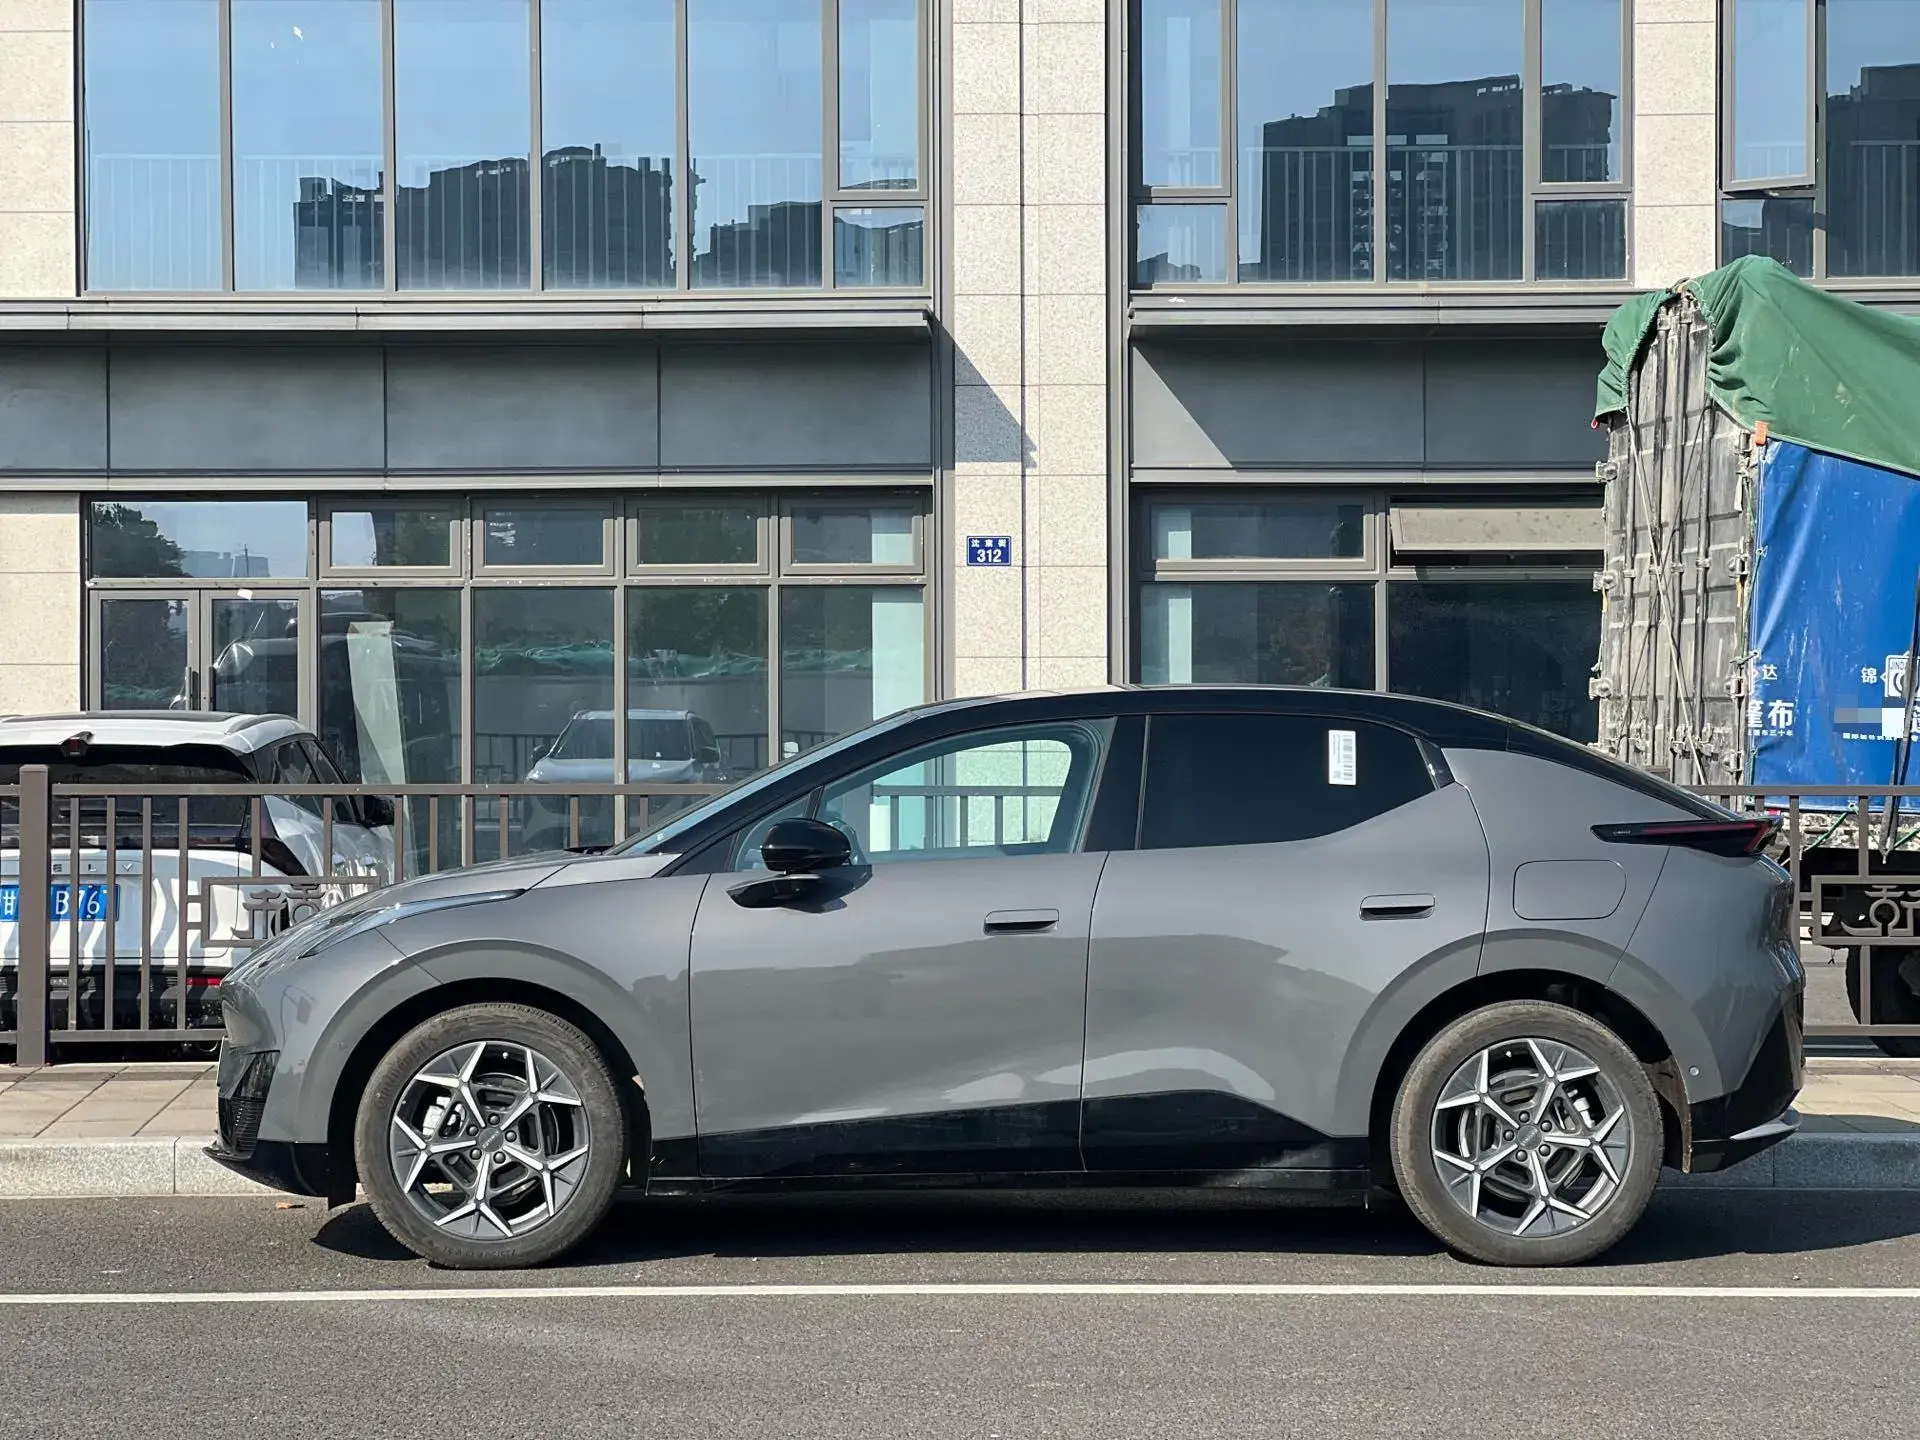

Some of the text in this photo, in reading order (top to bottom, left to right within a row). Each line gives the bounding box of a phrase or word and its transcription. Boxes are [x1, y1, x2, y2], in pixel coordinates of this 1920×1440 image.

[977, 549, 1002, 562] 312
[1762, 664, 1778, 680] 达
[1861, 667, 1877, 684] 锦
